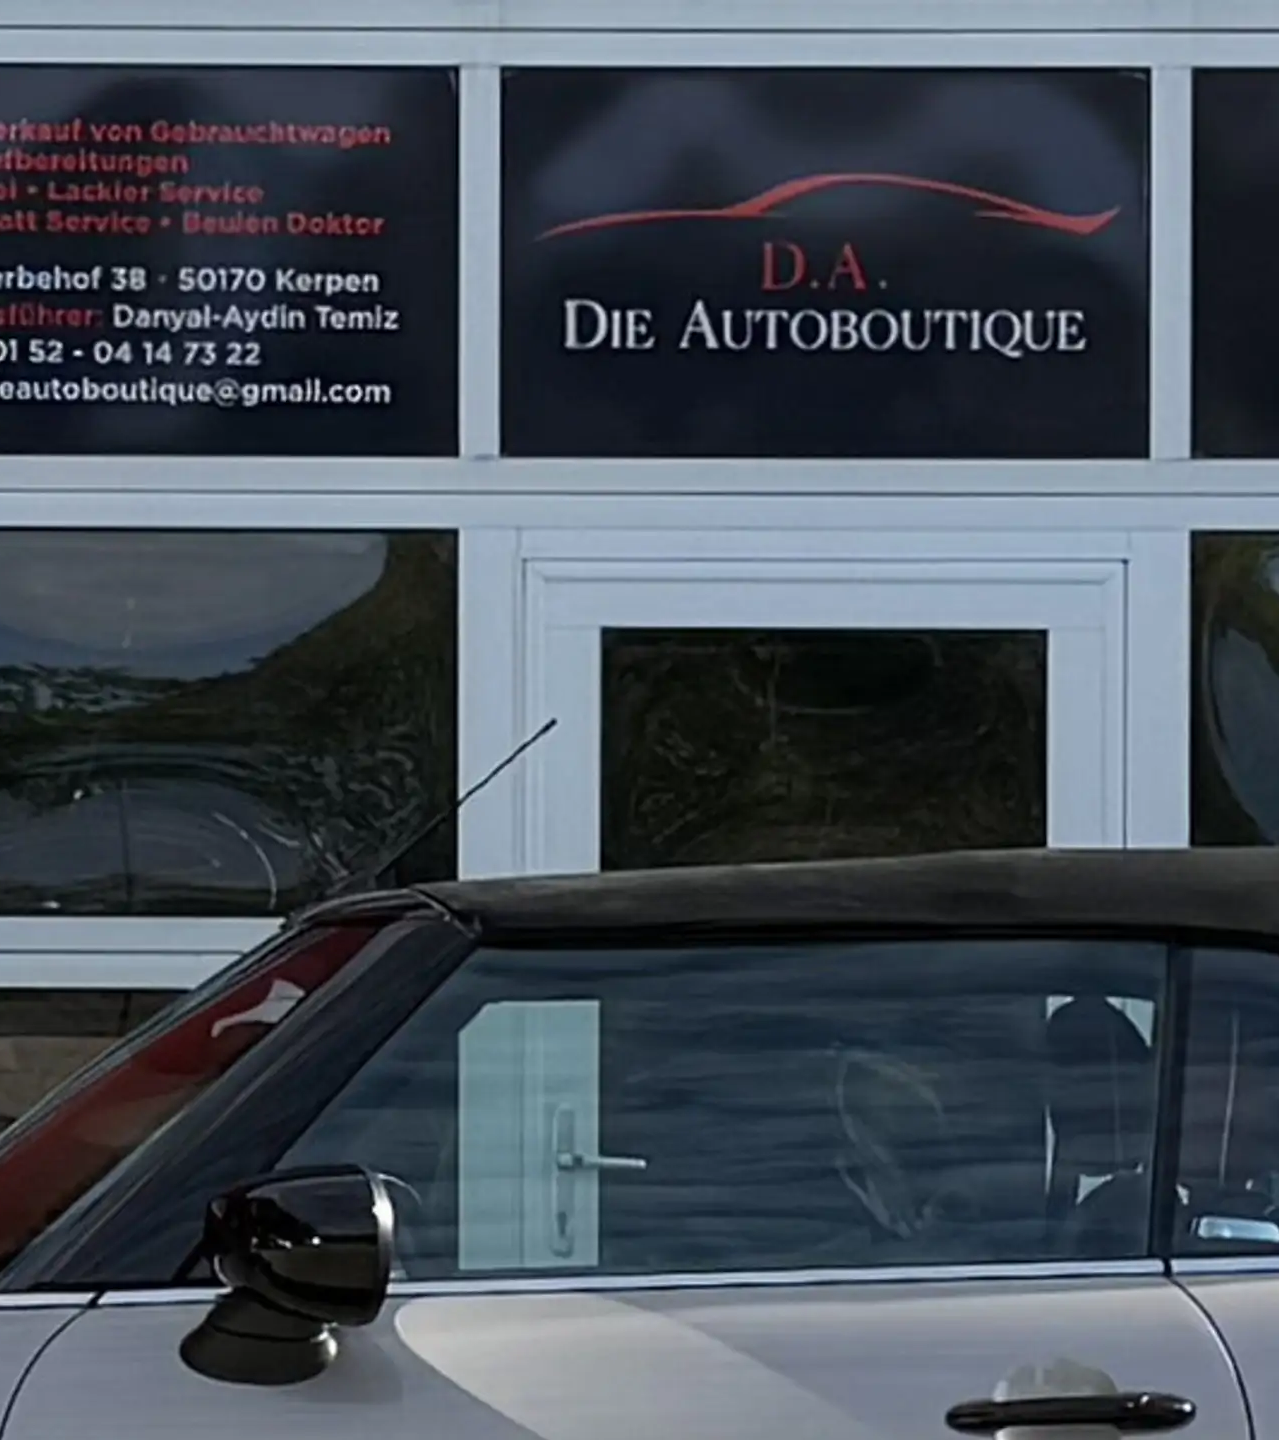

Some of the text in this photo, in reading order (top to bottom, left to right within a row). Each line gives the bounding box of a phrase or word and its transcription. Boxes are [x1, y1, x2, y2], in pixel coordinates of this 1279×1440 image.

[91, 124, 145, 143] von
[148, 121, 391, 149] Gebrauchtwagen
[45, 180, 151, 204] Lackier
[157, 182, 265, 206] Service
[45, 210, 153, 235] Service
[182, 211, 281, 236] Beulen
[286, 212, 386, 236] Doktor
[760, 241, 888, 291] D.A.
[178, 266, 267, 292] 50170
[275, 267, 379, 297] Kerpen
[112, 302, 306, 333] Danyal-Aydin
[314, 303, 400, 331] Temiz
[28, 338, 64, 364] 52
[93, 339, 133, 365] 04
[142, 340, 174, 365] 14
[183, 340, 217, 366] 73
[225, 341, 261, 366] 22
